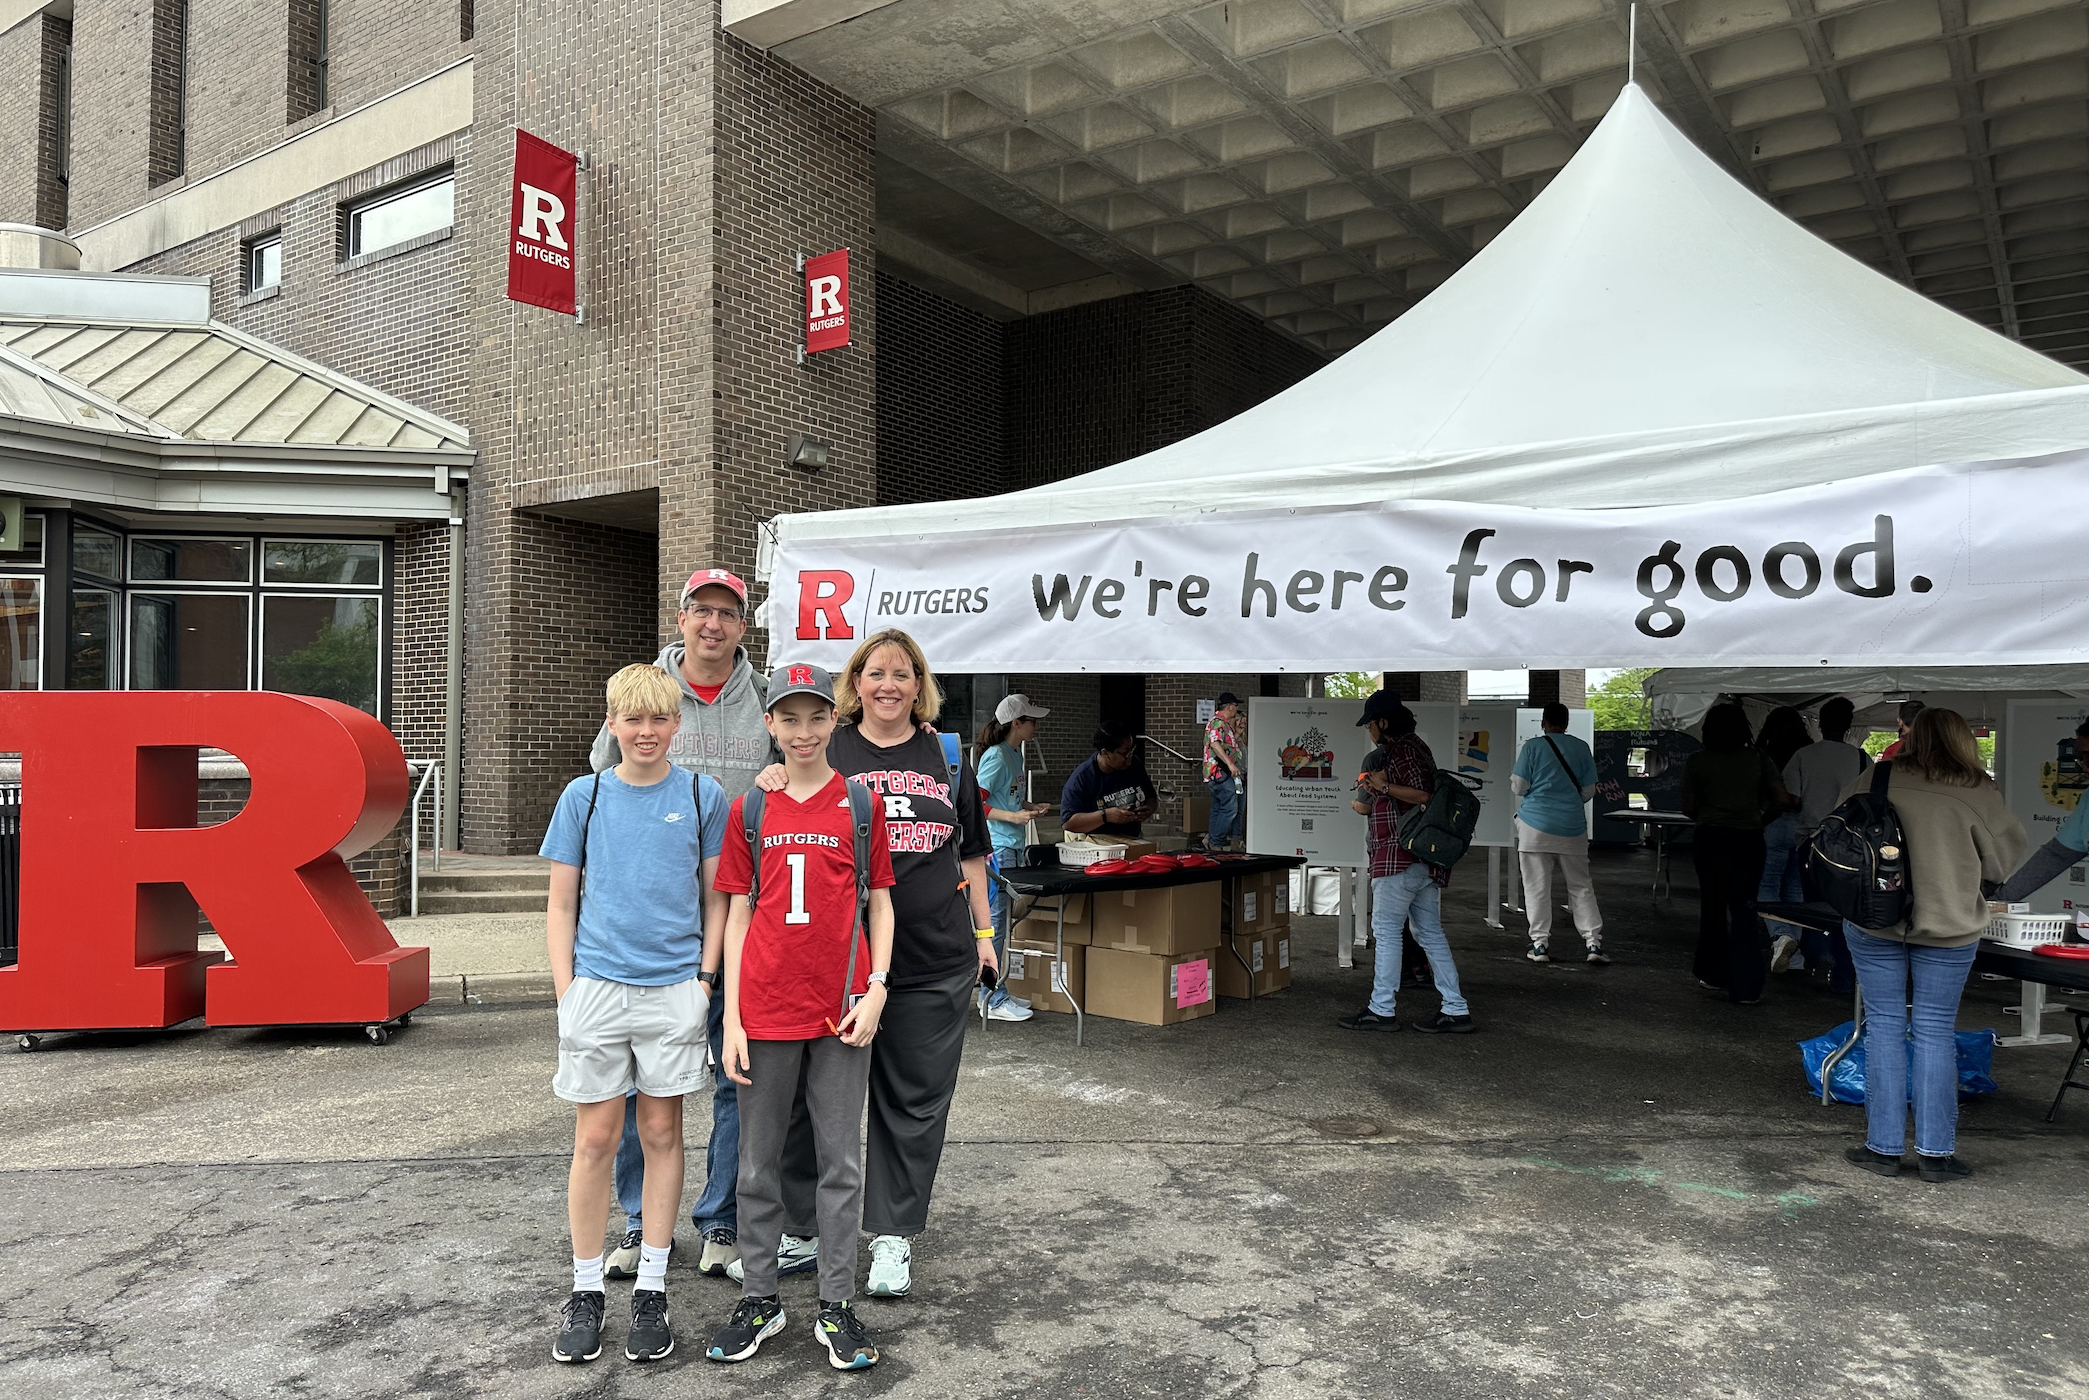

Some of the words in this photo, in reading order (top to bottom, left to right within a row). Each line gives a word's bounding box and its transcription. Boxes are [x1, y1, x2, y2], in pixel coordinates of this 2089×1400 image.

[518, 182, 569, 252] R
[515, 240, 570, 270] RUTGERS
[809, 274, 843, 318] R
[809, 315, 845, 332] RUTGERS
[707, 568, 729, 581] R
[1241, 551, 1409, 618] here
[1445, 528, 1594, 619] for
[1634, 514, 1934, 638] good.
[796, 569, 855, 640] R
[877, 586, 989, 616] RUTGERS
[787, 666, 816, 686] R
[666, 732, 762, 760] UTGERS
[883, 795, 917, 818] R
[2033, 813, 2061, 825] Building
[763, 833, 839, 849] RUTGERS
[884, 820, 954, 854] ERSITY
[0, 690, 430, 1030] R
[785, 852, 811, 925] 1
[2062, 899, 2073, 910] R
